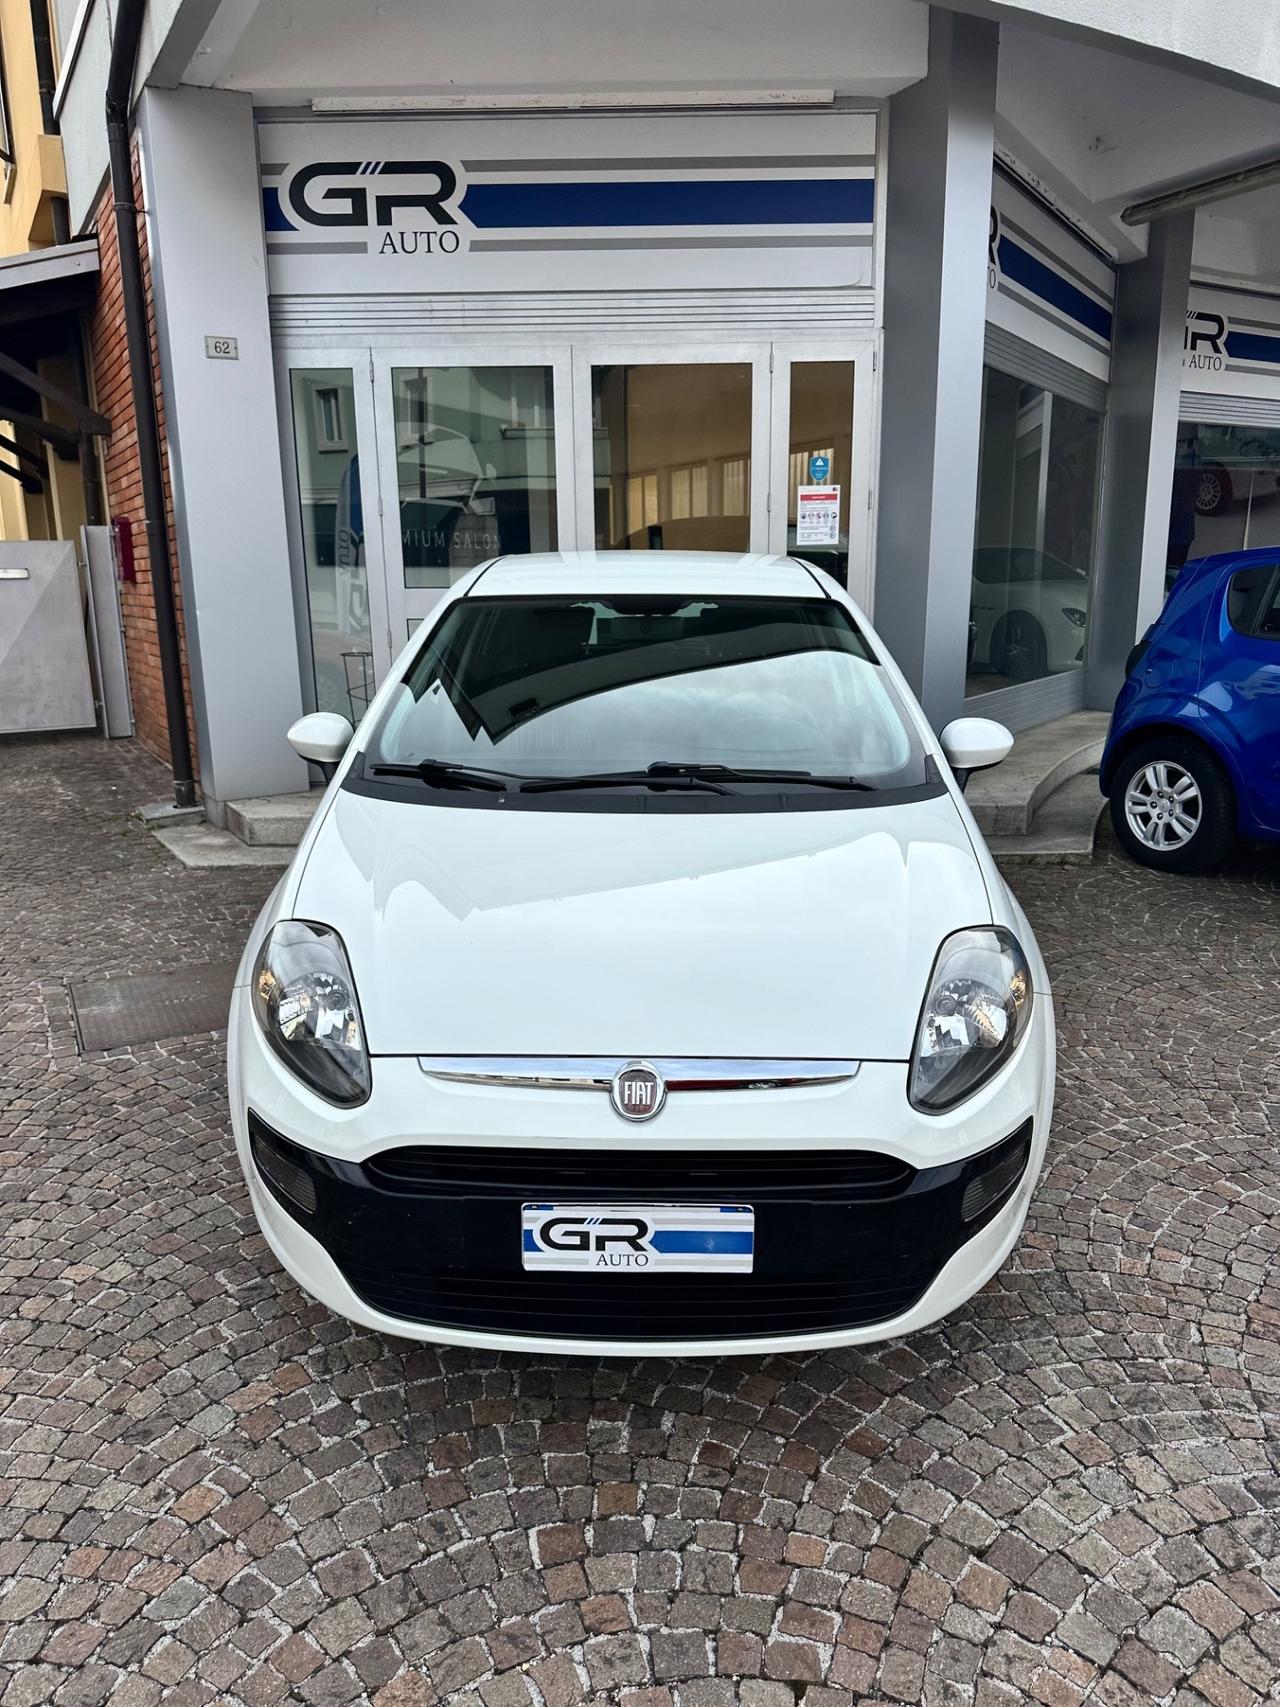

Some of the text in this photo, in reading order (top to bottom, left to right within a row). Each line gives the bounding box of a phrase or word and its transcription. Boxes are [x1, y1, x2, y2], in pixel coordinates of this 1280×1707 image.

[288, 160, 459, 227] GR
[378, 230, 460, 255] AUTO
[214, 340, 231, 354] 62
[1188, 353, 1222, 371] AUTO
[624, 1081, 654, 1105] FIAT
[539, 1217, 649, 1252] GR
[595, 1254, 649, 1267] AUTO
